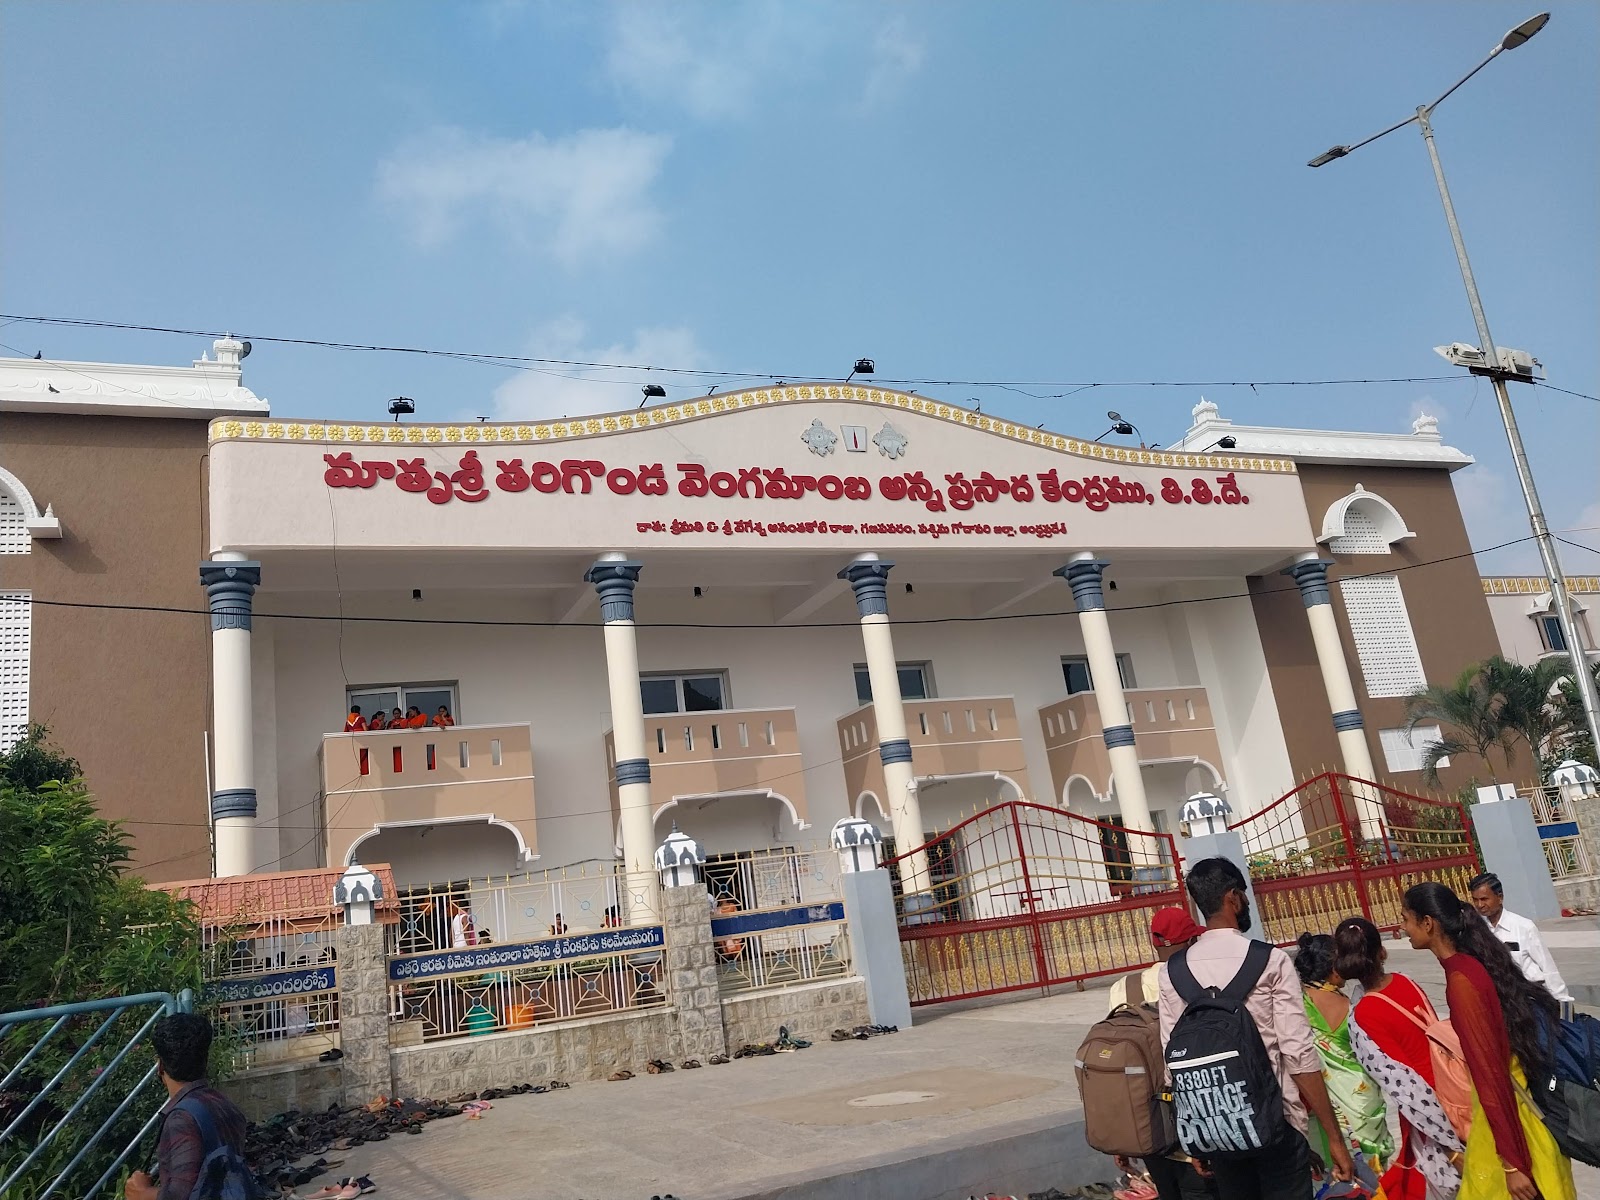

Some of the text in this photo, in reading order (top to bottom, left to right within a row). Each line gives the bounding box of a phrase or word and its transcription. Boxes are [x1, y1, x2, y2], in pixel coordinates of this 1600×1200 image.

[323, 450, 490, 504] మాతృశ్రీ
[496, 458, 669, 496] తరిగొండ
[678, 463, 872, 501] వెంగమాంబ
[1037, 468, 1155, 512] కేంద్రము,
[706, 521, 719, 533] &
[722, 519, 733, 535] శ్రీ
[1210, 1065, 1228, 1086] FT
[1173, 1080, 1252, 1120] VANTAGE
[1176, 1107, 1263, 1156] POINT
